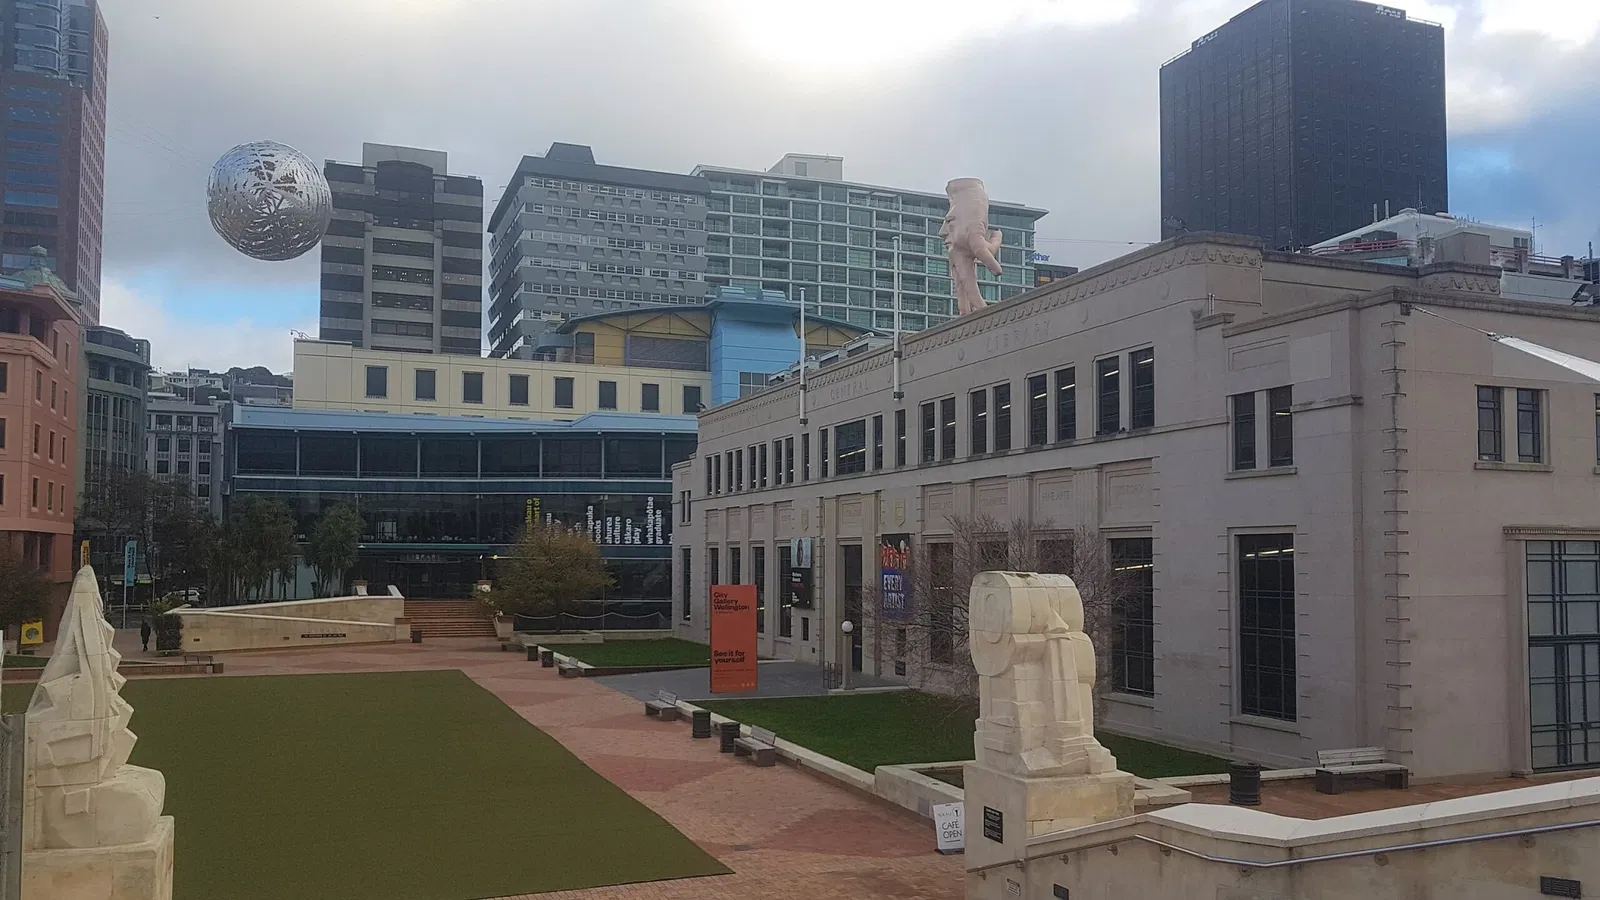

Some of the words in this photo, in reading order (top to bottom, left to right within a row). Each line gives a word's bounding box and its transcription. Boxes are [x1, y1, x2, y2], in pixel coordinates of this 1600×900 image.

[987, 319, 1051, 353] LIBRARY
[829, 378, 868, 400] CENTRAL
[604, 516, 612, 544] ahurea
[613, 516, 621, 544] culture
[632, 527, 642, 544] play
[654, 509, 663, 544] graduate
[883, 574, 903, 591] EVERY
[883, 592, 905, 610] ARTIST
[941, 819, 960, 830] CAFÉ
[943, 830, 962, 839] OPEN
